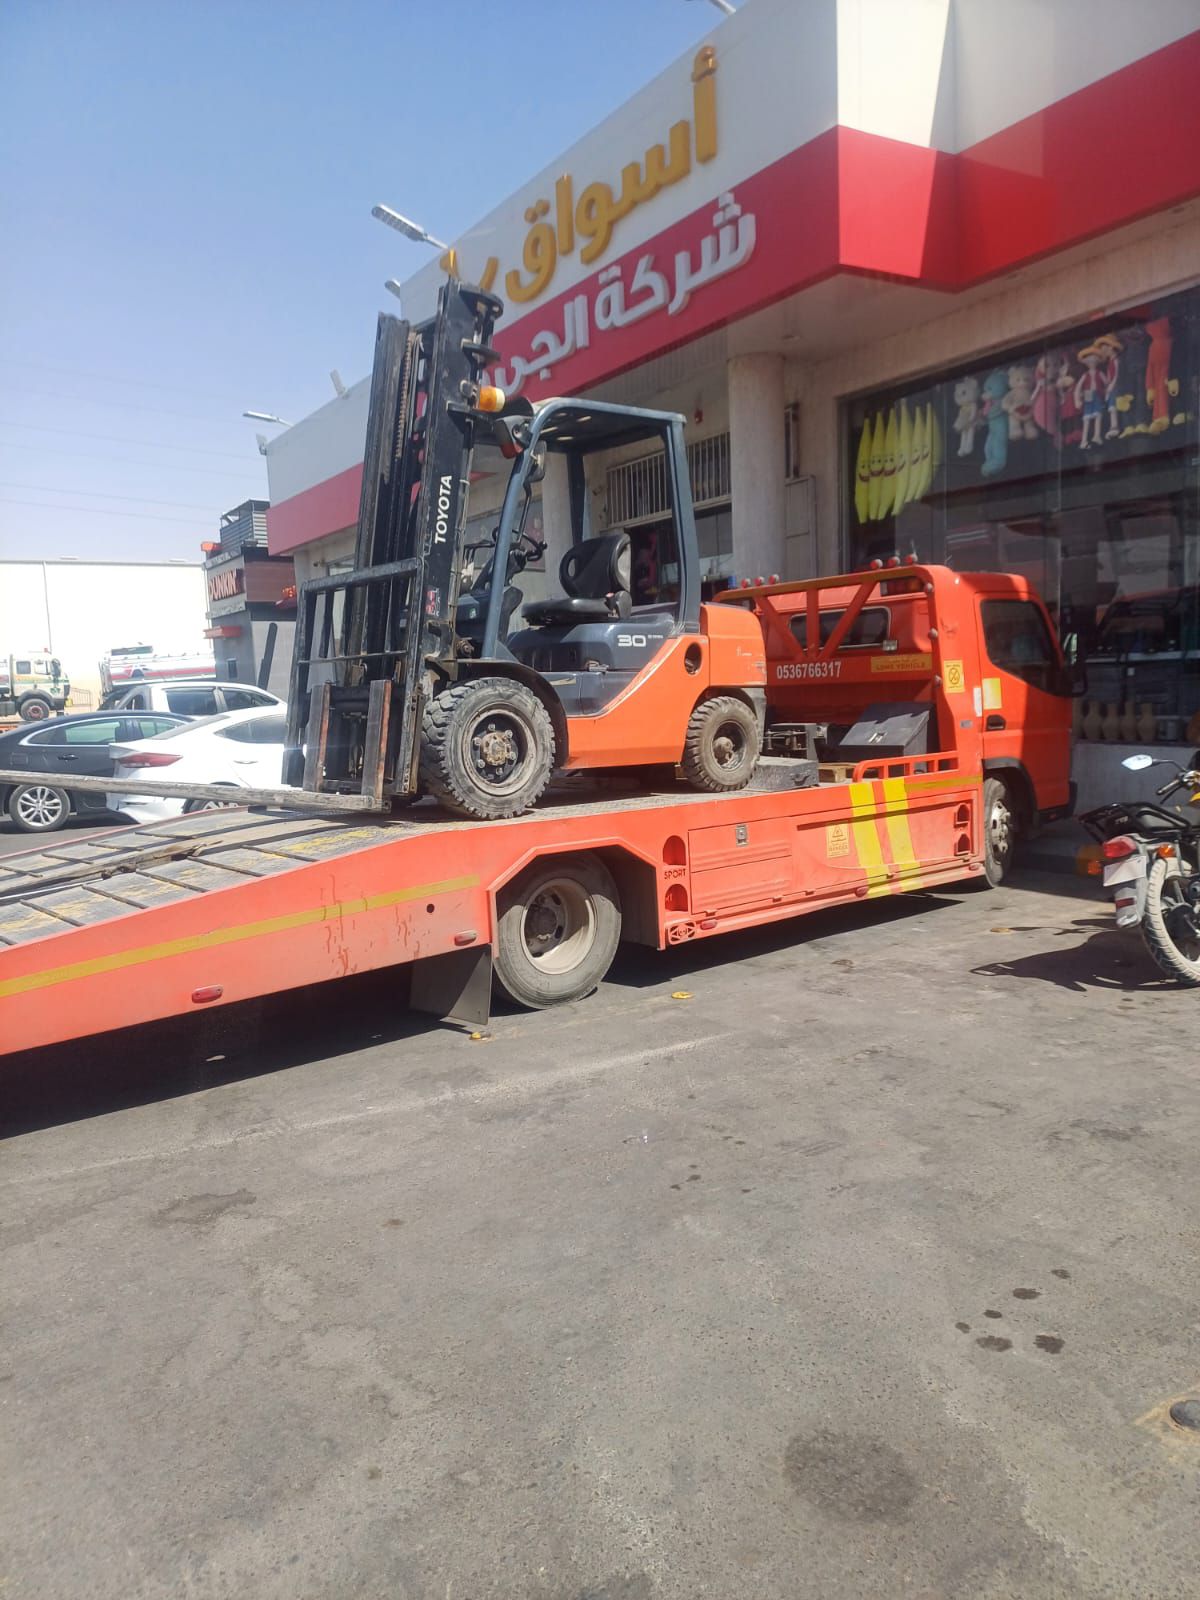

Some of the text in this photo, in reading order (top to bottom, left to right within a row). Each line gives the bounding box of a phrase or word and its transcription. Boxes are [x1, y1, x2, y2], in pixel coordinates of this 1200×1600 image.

[504, 44, 719, 304] أسواق
[594, 191, 757, 332] شركة
[434, 475, 453, 544] TOYOTA
[617, 634, 647, 647] 30
[776, 660, 842, 680] 0536766317
[664, 868, 686, 880] SPORT
